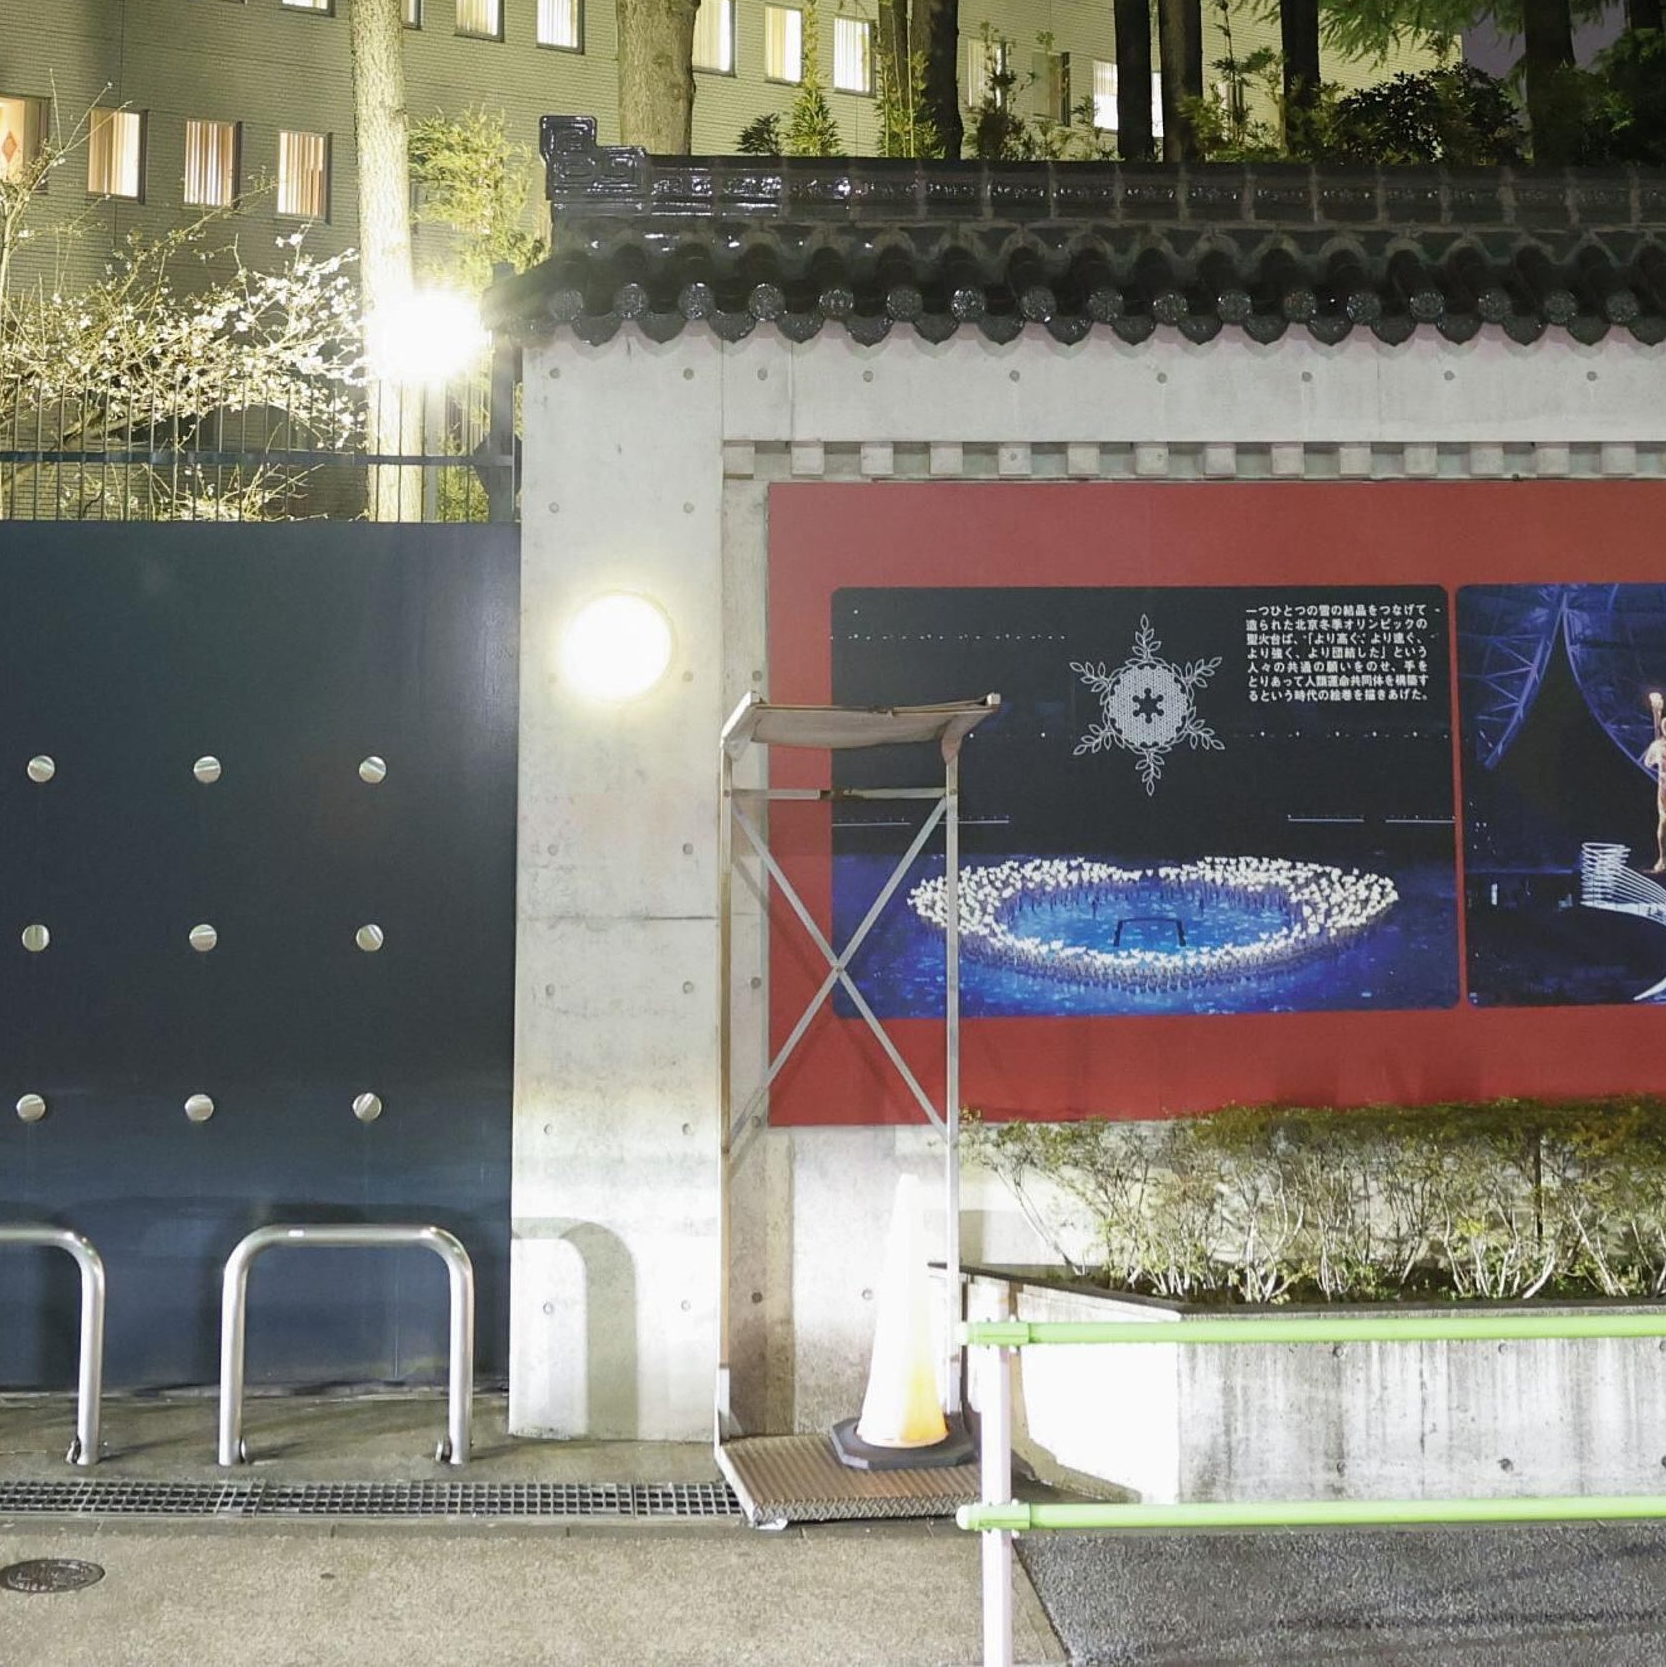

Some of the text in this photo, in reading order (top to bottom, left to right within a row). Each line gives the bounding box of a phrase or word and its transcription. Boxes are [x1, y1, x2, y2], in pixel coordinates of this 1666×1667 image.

[1246, 604, 1427, 617] 一つひとつの雪の結晶をつなげて
[1246, 619, 1428, 632] 造られた北京冬季オリンピックの
[1247, 647, 1428, 659] より強く、より団結した」という
[1247, 661, 1428, 673] 人々の共通の願いをのせ、手を
[1248, 674, 1429, 687] とりあって人類運命共同体を構築す
[1249, 689, 1428, 702] るという時代の絵巻を描きあげた。
